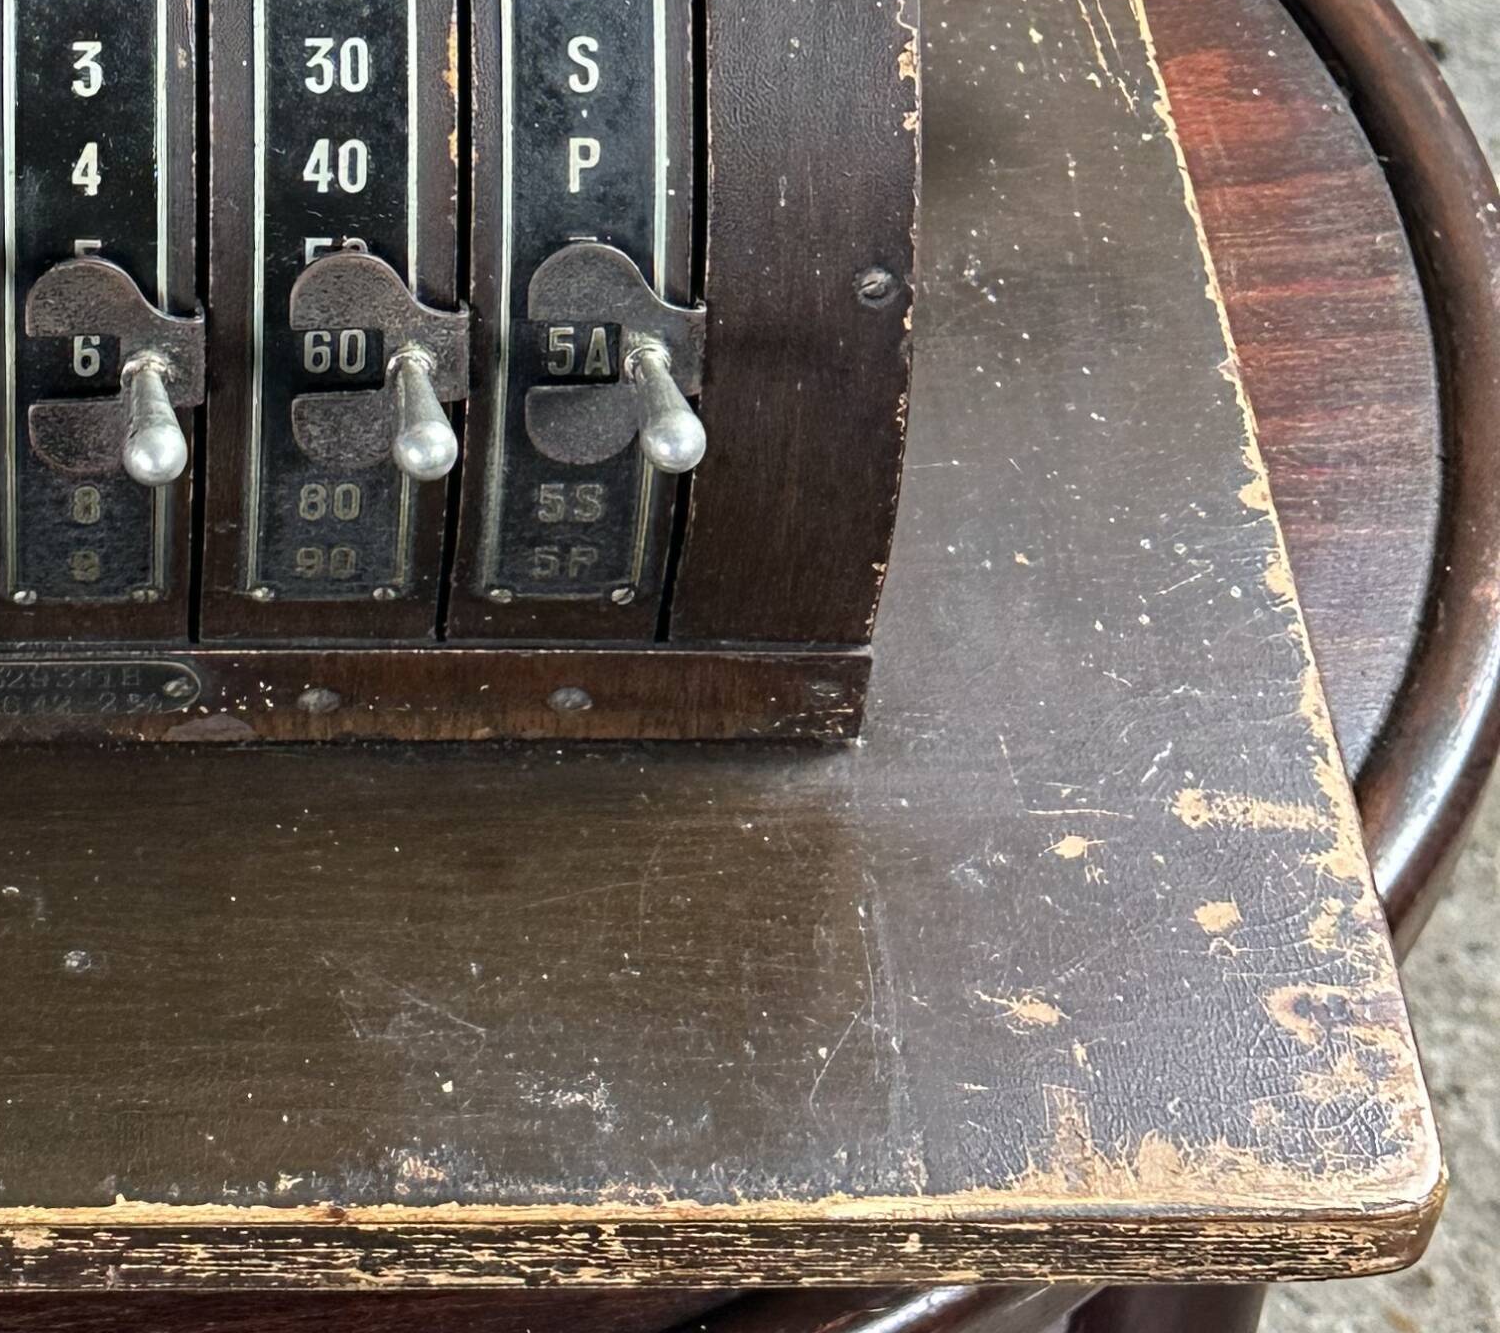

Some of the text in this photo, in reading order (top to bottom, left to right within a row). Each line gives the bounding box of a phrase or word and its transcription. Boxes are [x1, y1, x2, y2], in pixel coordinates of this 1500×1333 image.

[71, 41, 102, 97] 3
[304, 37, 369, 94] 30
[567, 35, 600, 93] S
[72, 142, 101, 196] 4
[302, 138, 368, 194] 40
[569, 137, 601, 193] P
[73, 335, 101, 377] 6
[304, 329, 367, 374] 60
[548, 326, 612, 377] 5A
[300, 483, 362, 521] 80
[537, 483, 604, 523] 5S
